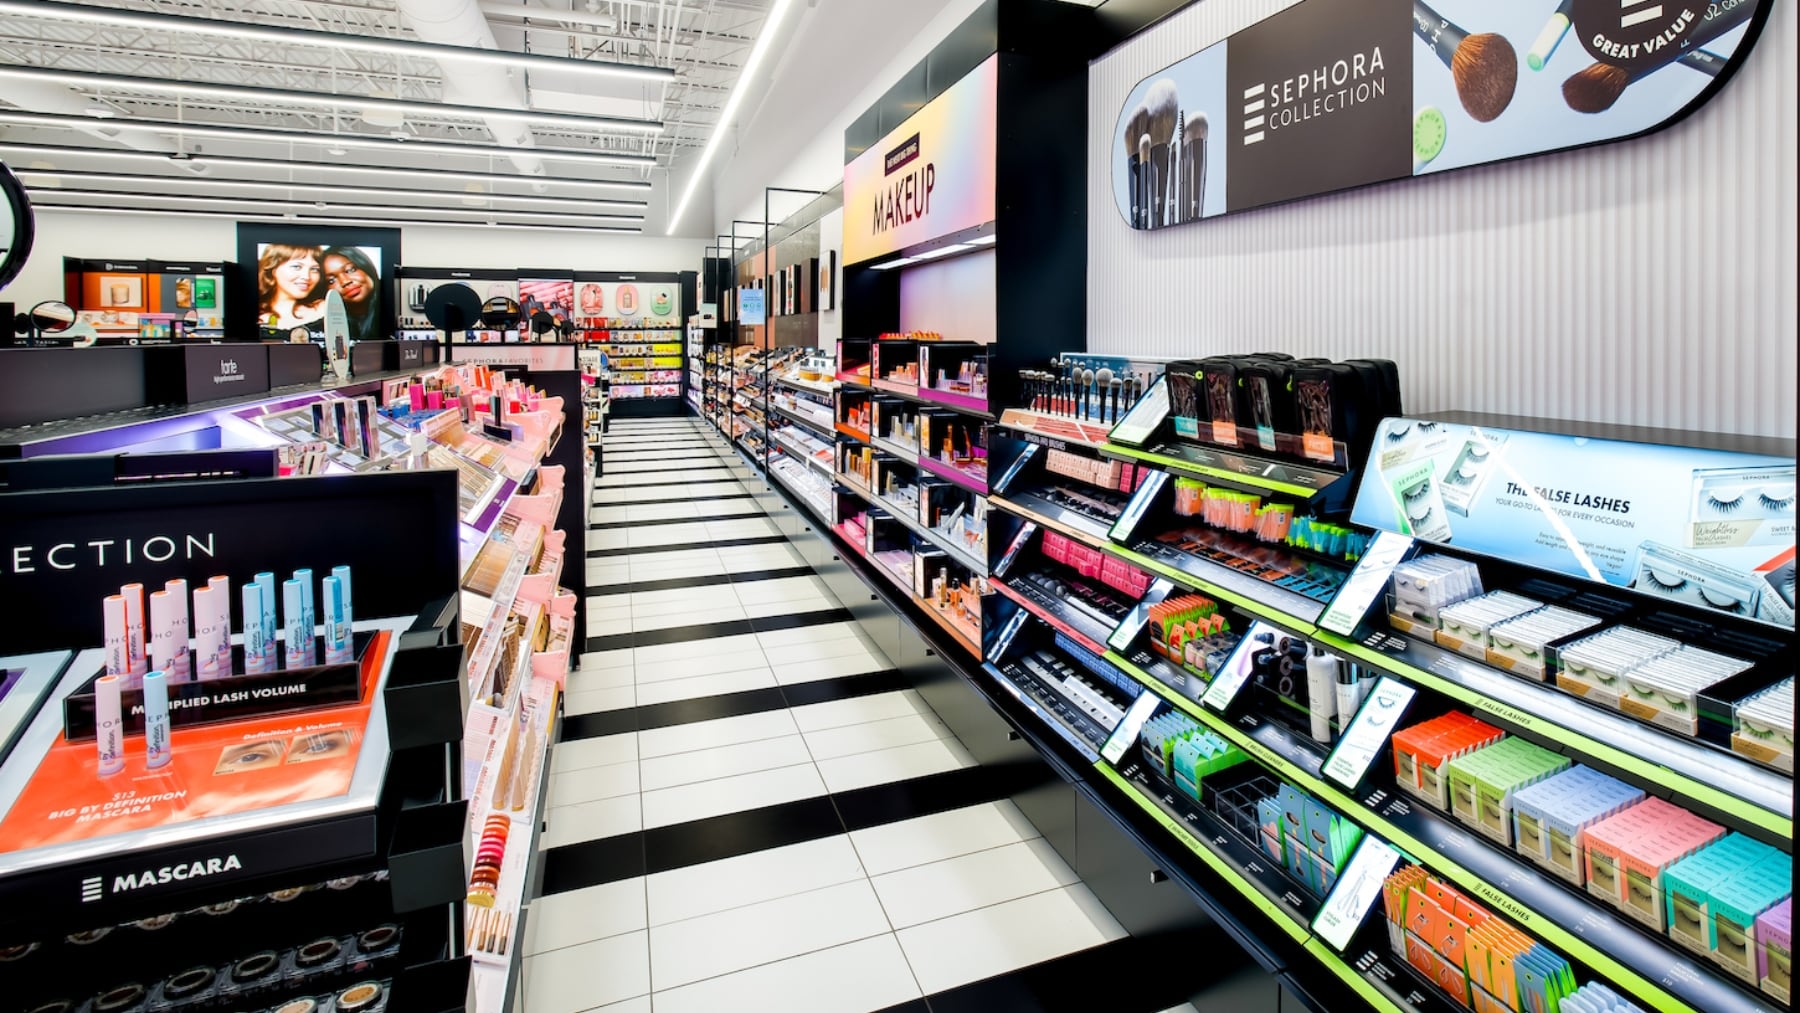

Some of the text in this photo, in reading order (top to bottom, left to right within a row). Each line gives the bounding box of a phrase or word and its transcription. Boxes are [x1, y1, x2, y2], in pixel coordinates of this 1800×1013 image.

[1592, 8, 1695, 59] GREAT VALUE
[1270, 46, 1385, 108] SEPHORA
[1269, 77, 1386, 130] COLLECTION
[873, 163, 936, 236] MAKEUP
[220, 359, 238, 375] tarte
[1398, 468, 1428, 486] SEPHORA
[1496, 497, 1512, 506] YOUR
[1512, 501, 1533, 510] GO-TO
[1558, 508, 1572, 517] FOR
[1572, 511, 1593, 521] EVERY
[1594, 515, 1635, 529] OCCASION
[1533, 486, 1572, 504] FALSE
[1573, 493, 1631, 514] LASHES
[1696, 522, 1739, 538] Weightless
[0, 533, 214, 573] ECTION
[1677, 569, 1705, 583] SEPHORA
[131, 683, 307, 715] MIPLIED LASH VOLUME
[1482, 702, 1532, 725] FALSE LASHES
[243, 728, 293, 741] Definition
[306, 722, 343, 731] Volume
[48, 790, 187, 820] BIG BY DEFINITION
[75, 804, 153, 824] MASCARA
[112, 854, 243, 893] MASCARA
[1481, 888, 1531, 921] FALSE LASHES
